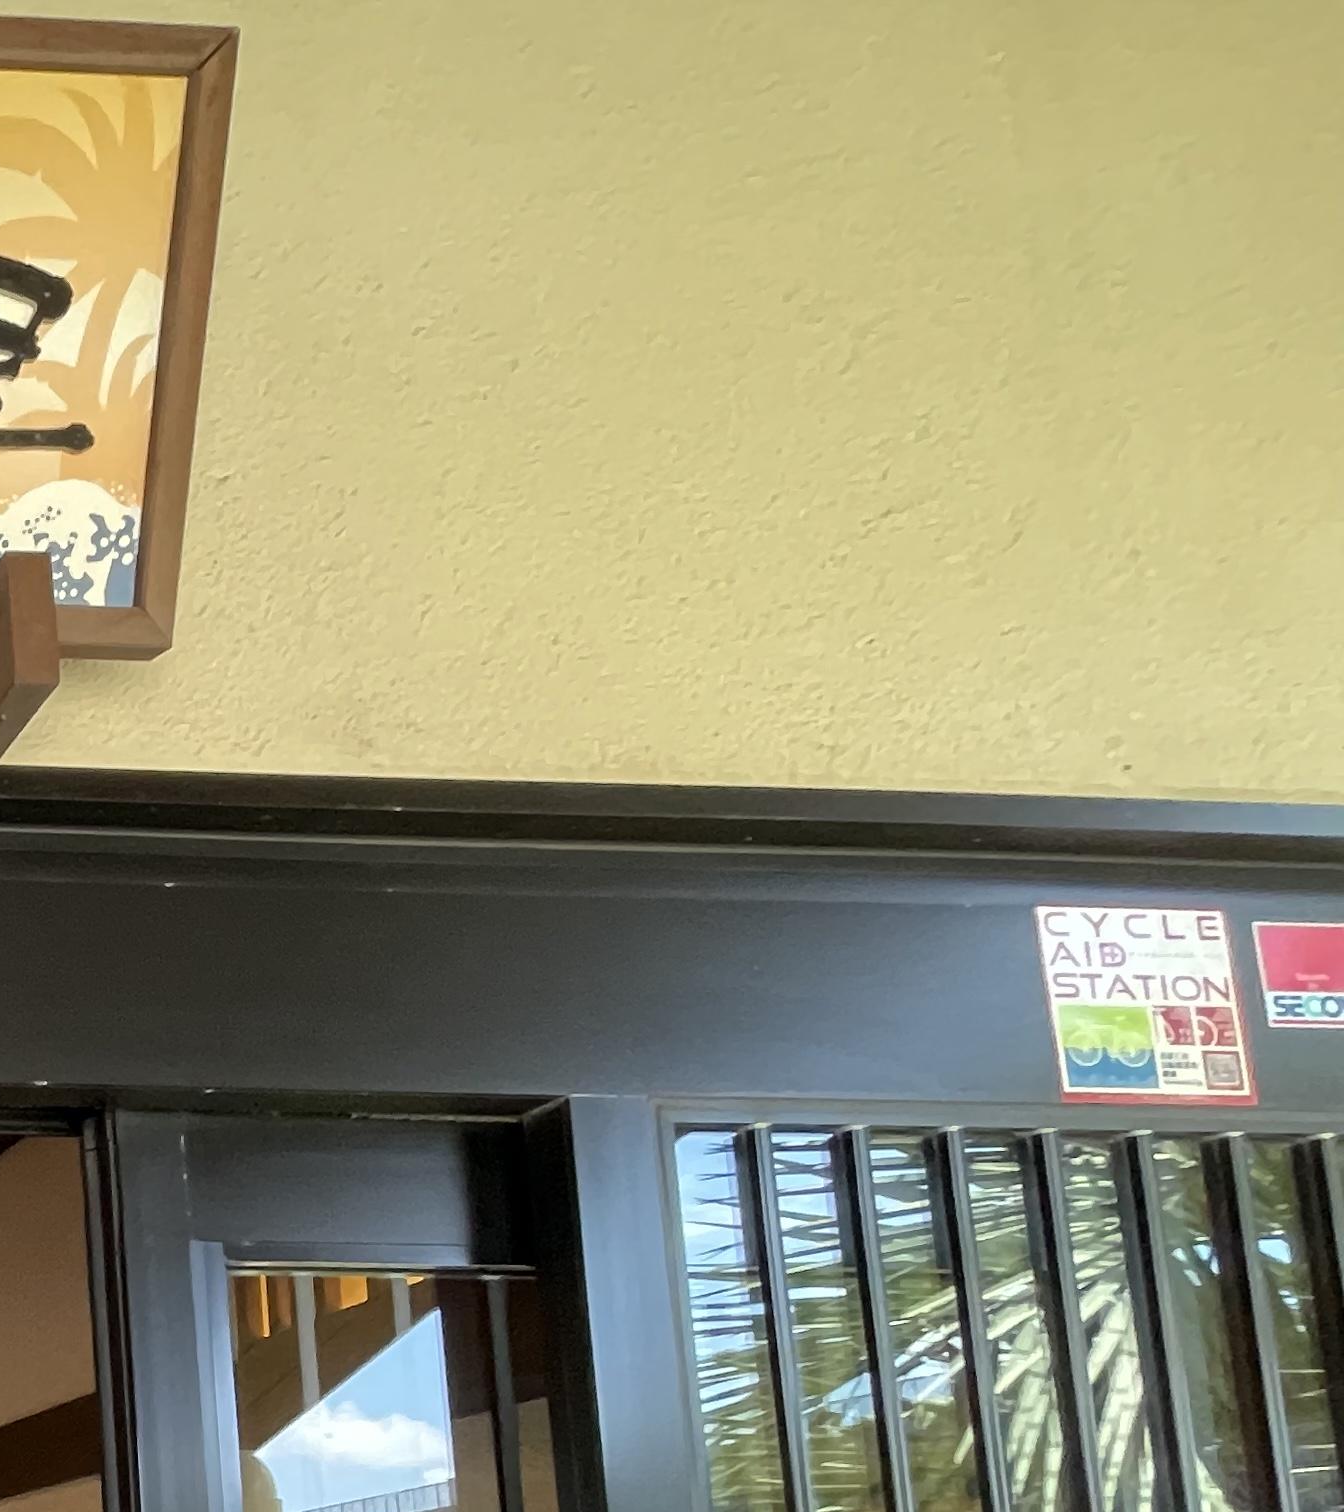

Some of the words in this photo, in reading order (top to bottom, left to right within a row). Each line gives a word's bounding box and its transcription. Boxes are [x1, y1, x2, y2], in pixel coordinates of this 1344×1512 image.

[1043, 911, 1221, 941] CYCLE
[1049, 942, 1127, 968] AID
[1053, 973, 1231, 1002] STATION
[1273, 995, 1344, 1018] SECO
